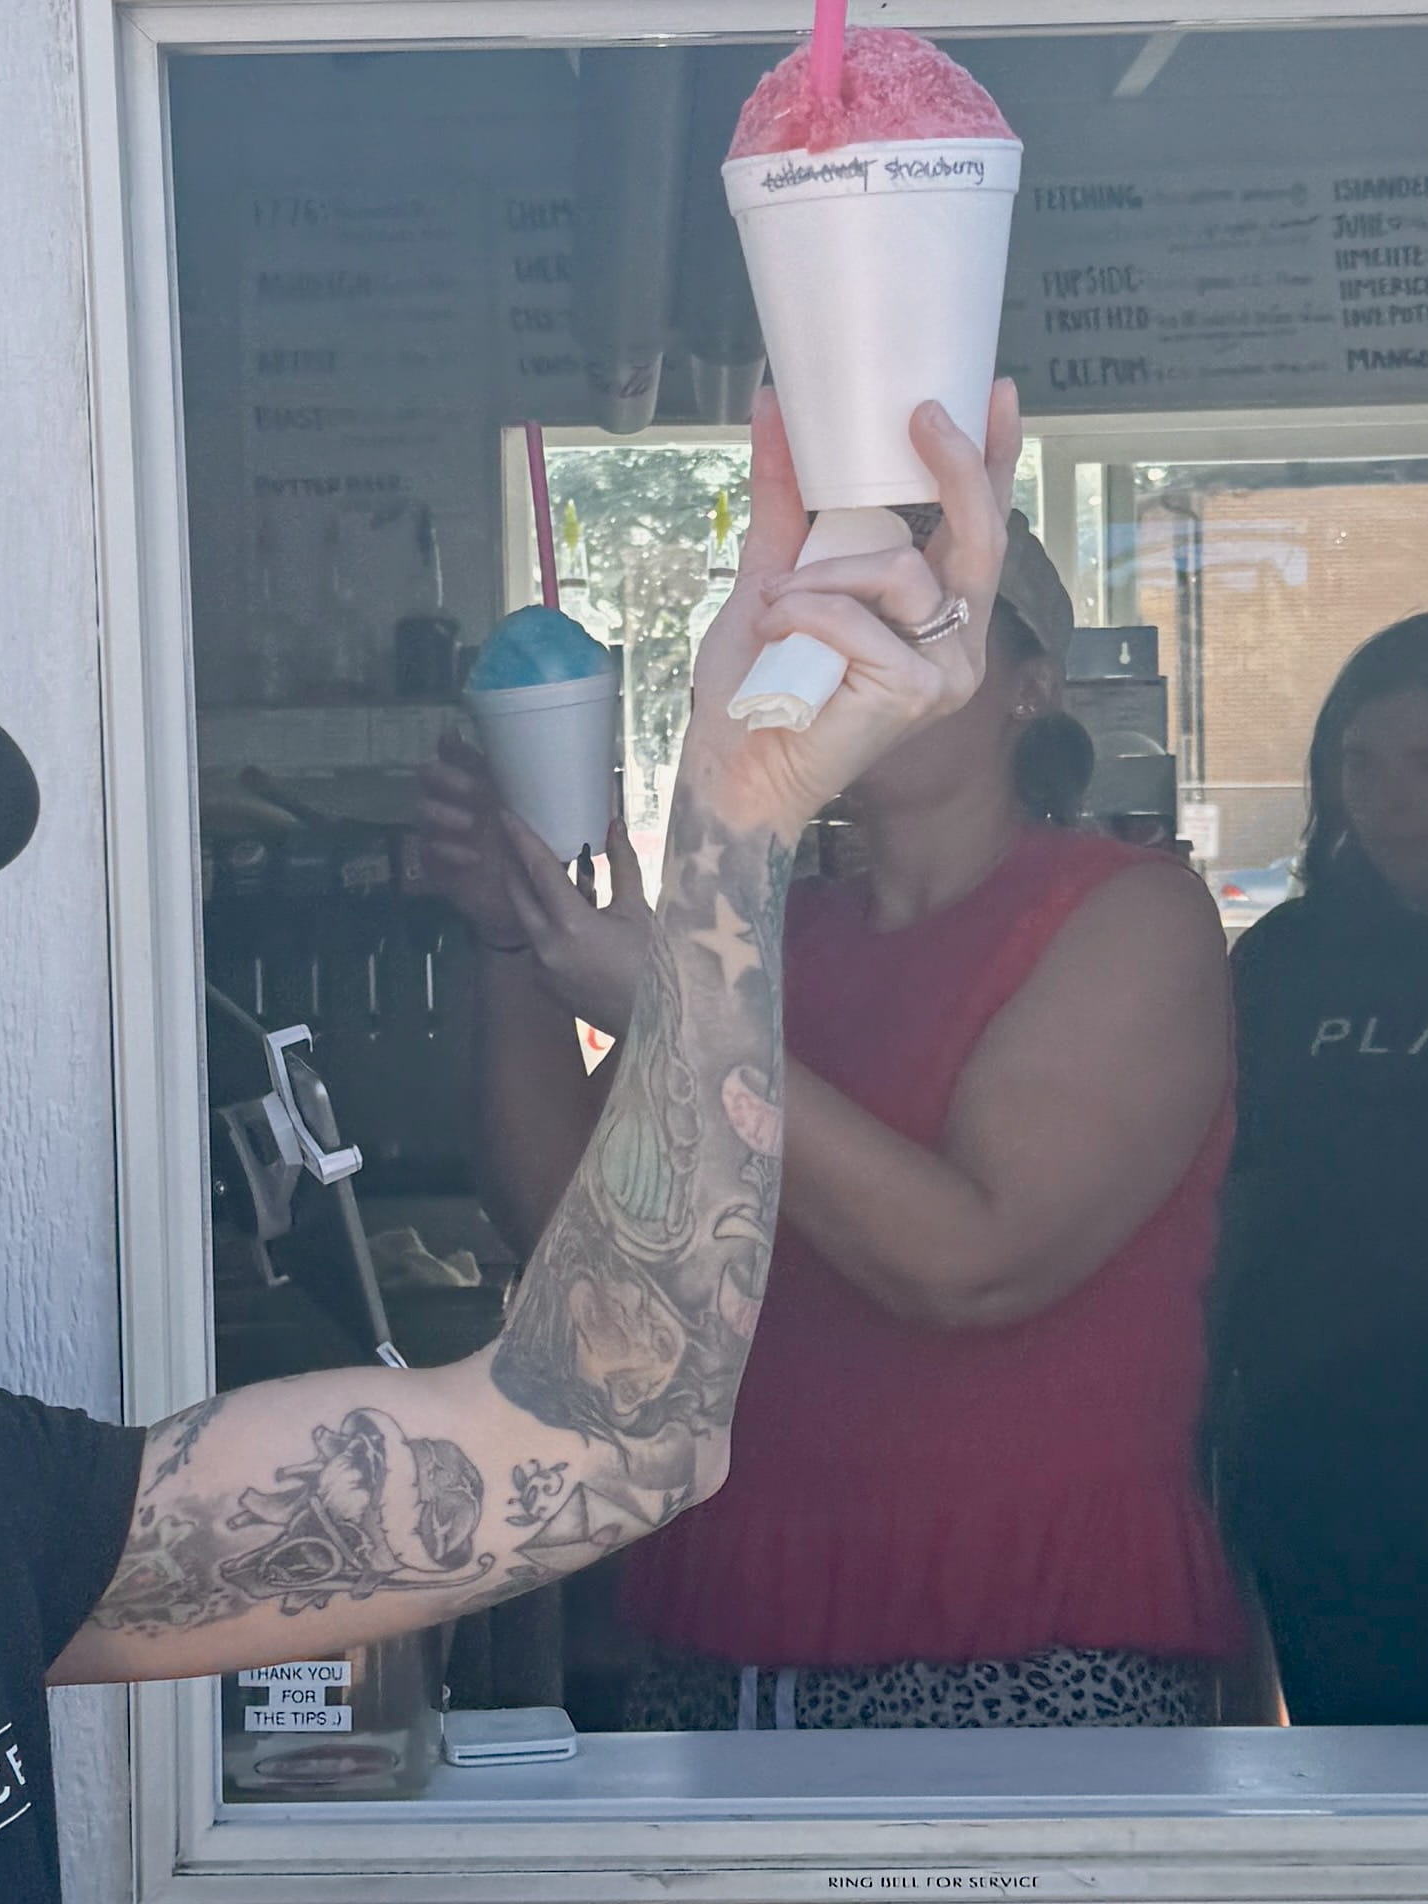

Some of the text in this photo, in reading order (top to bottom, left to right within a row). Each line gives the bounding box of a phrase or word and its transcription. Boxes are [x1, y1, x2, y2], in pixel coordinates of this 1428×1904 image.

[885, 155, 984, 185] strawberry
[308, 1666, 343, 1681] YOU
[282, 1690, 316, 1704] FOR
[253, 1711, 286, 1725] THE
[291, 1711, 327, 1726] TIPS
[828, 1876, 1040, 1889] RING BELL FOR SERVICE
